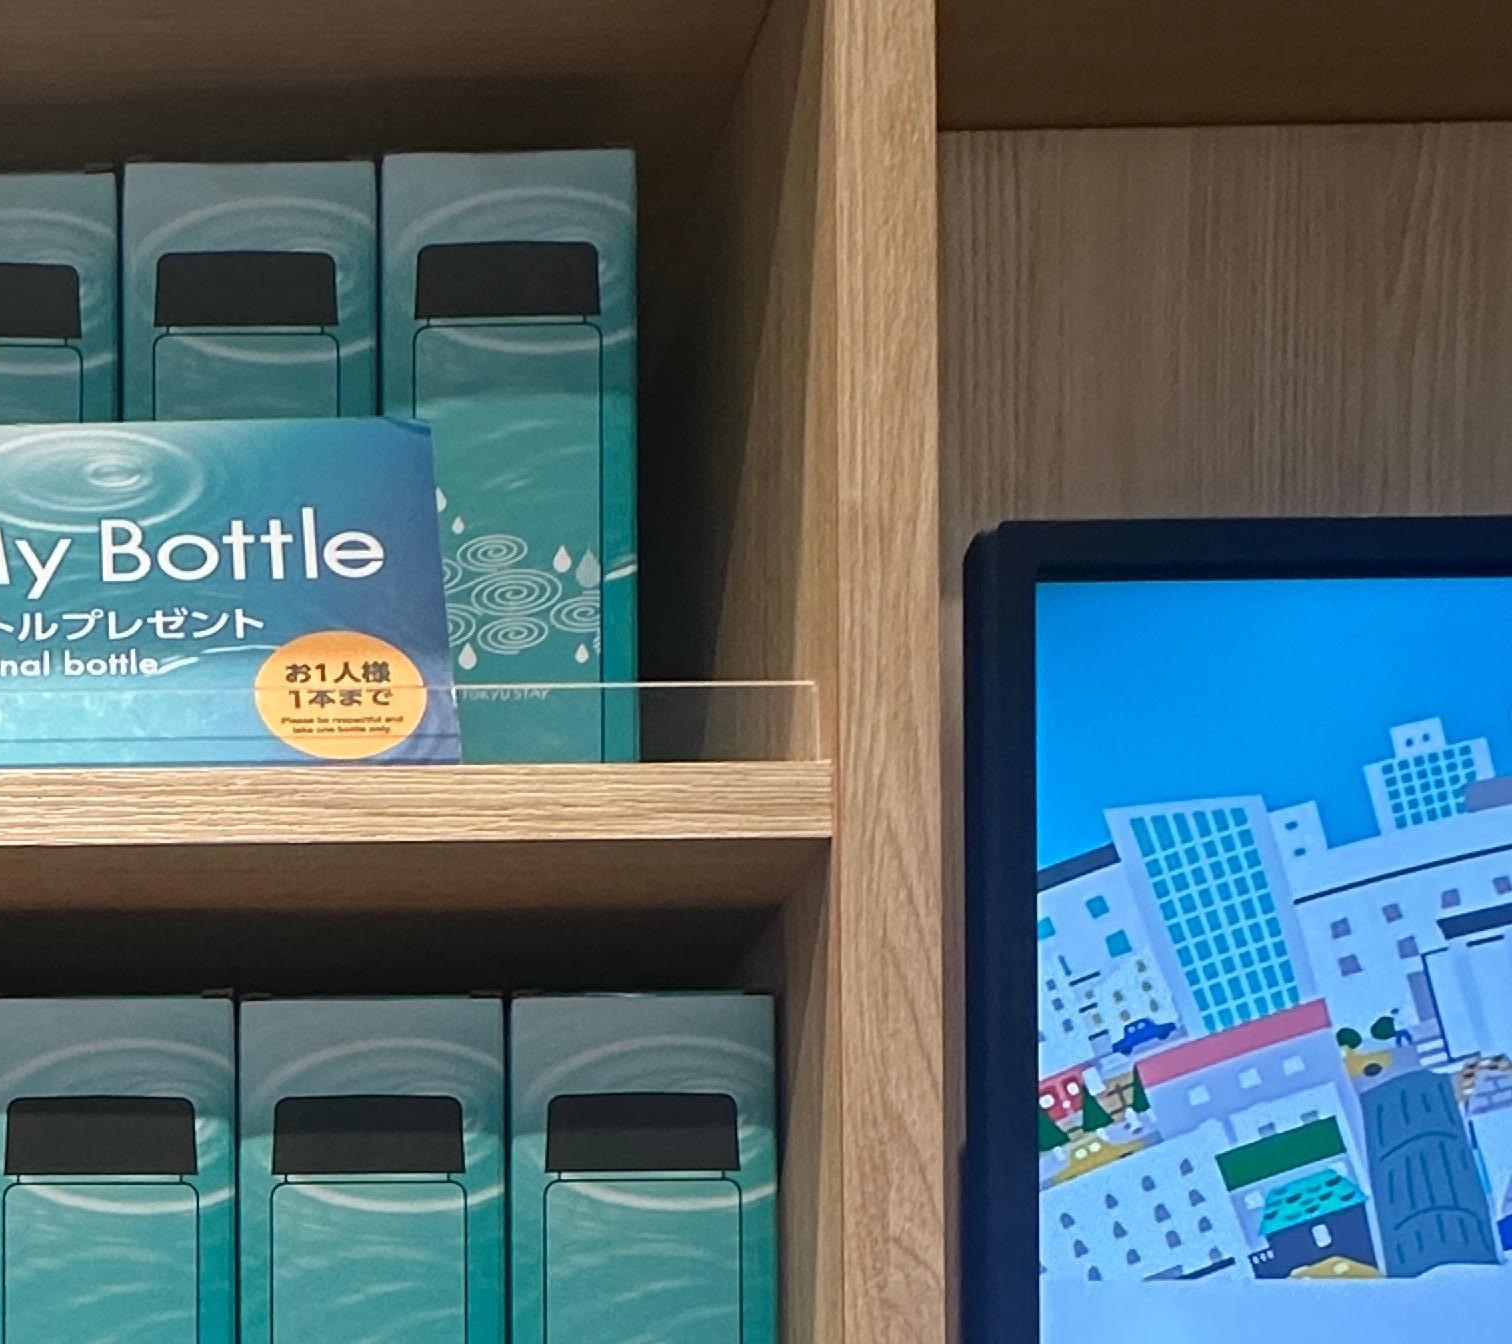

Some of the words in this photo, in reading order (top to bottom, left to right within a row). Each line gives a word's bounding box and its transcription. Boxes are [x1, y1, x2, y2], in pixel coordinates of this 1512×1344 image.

[100, 508, 385, 581] Bottle
[64, 649, 160, 680] bottle
[285, 661, 392, 684] お1人様
[288, 688, 393, 709] 1本まで
